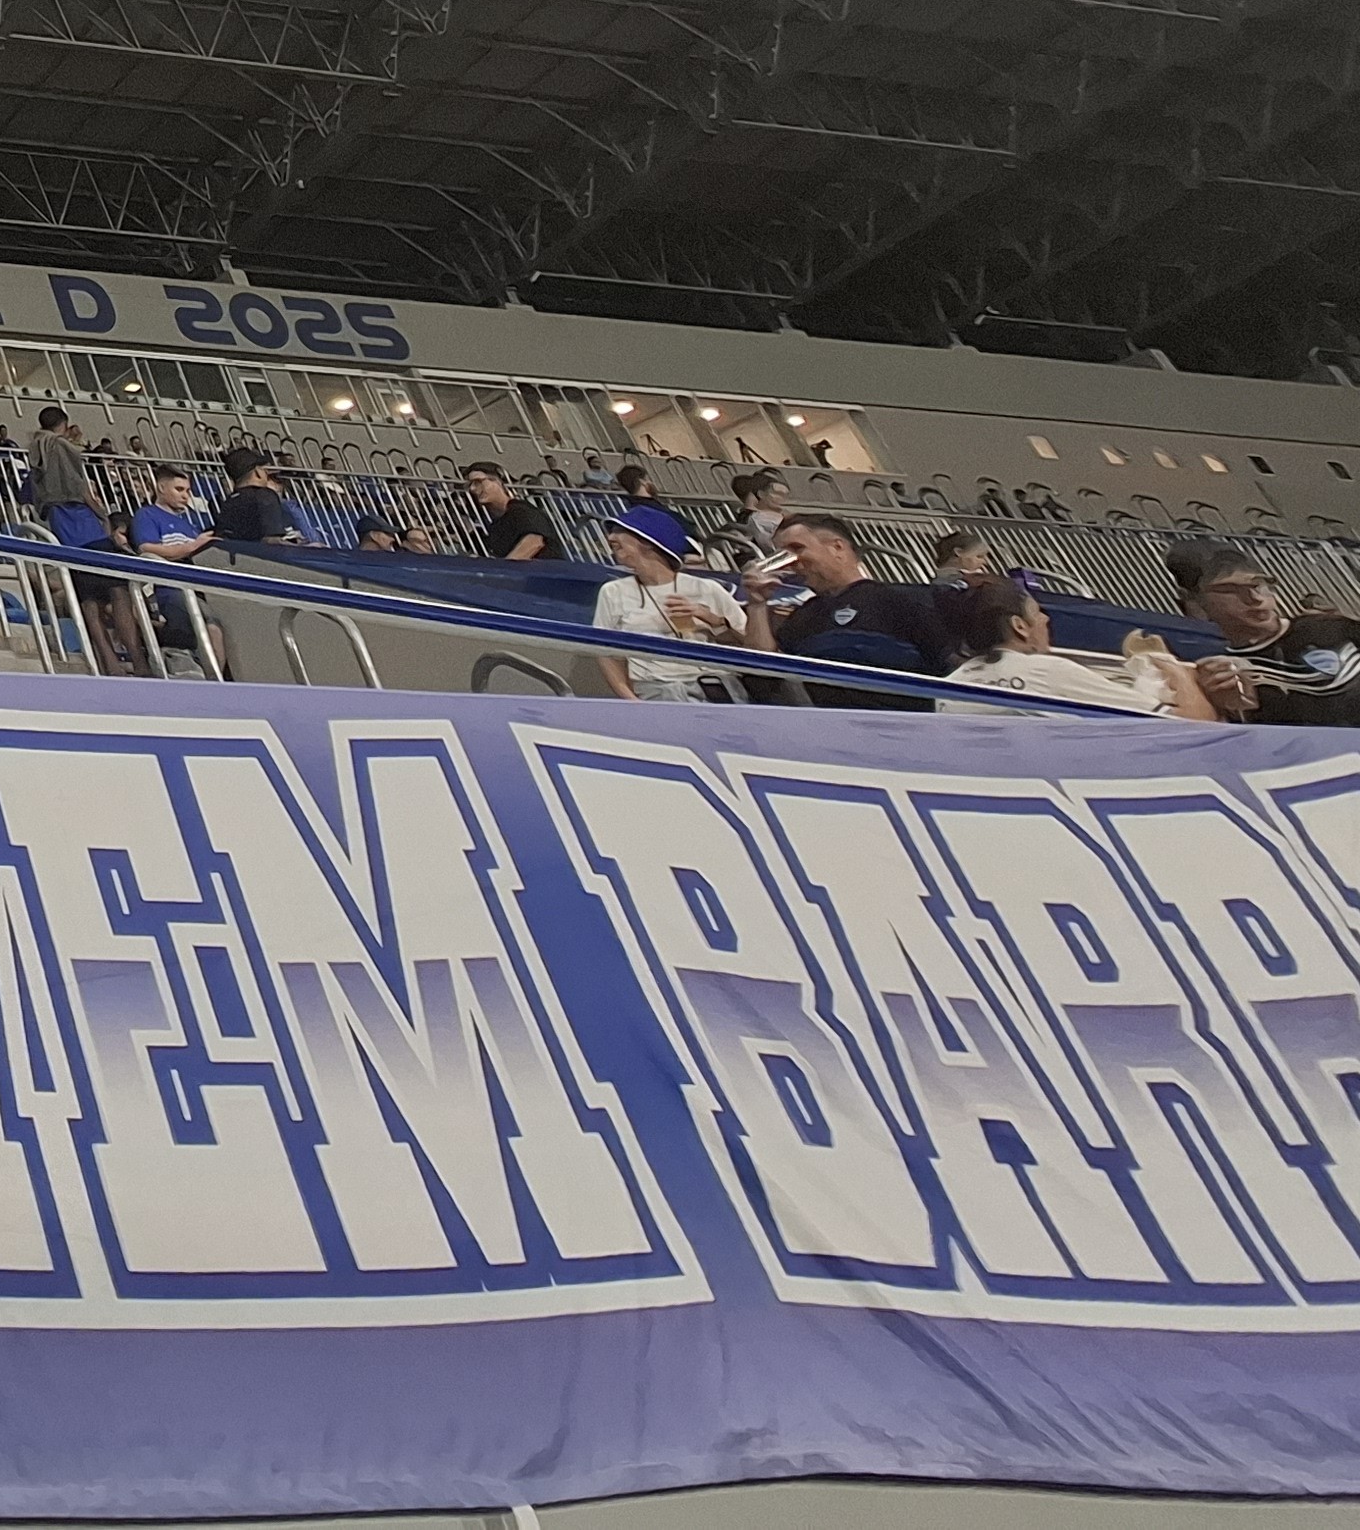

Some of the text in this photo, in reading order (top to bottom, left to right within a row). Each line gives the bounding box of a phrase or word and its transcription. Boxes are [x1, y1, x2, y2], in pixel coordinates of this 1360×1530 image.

[49, 273, 117, 332] D
[163, 284, 410, 361] 2025
[510, 722, 1360, 1332] BARR
